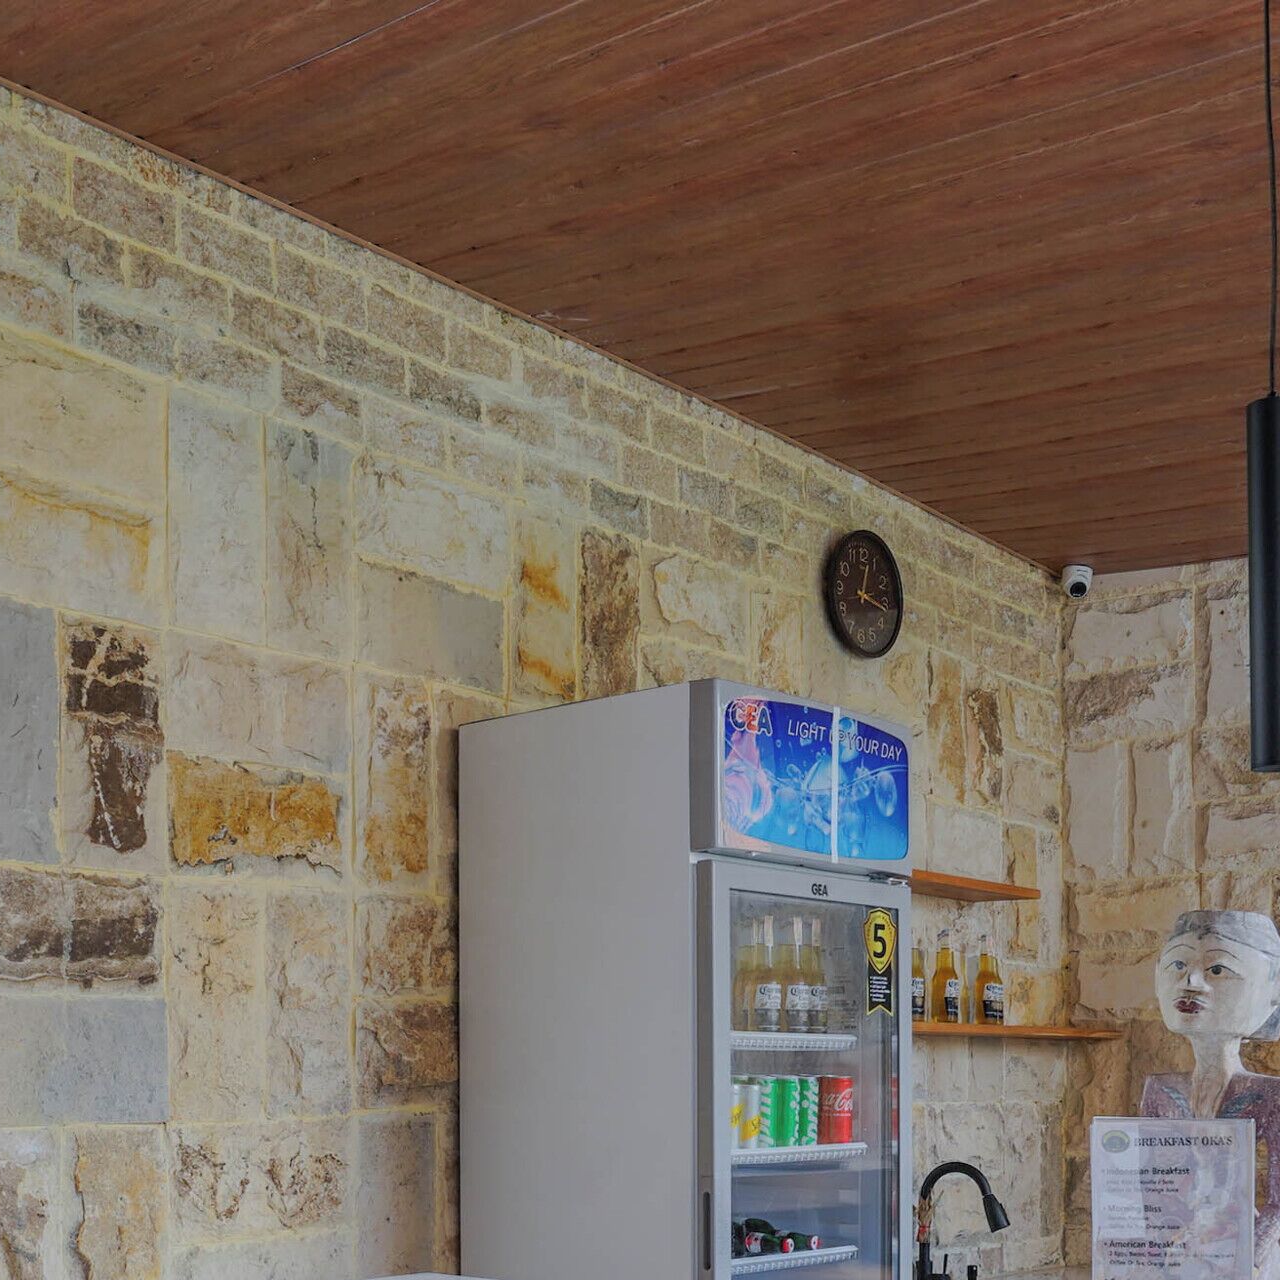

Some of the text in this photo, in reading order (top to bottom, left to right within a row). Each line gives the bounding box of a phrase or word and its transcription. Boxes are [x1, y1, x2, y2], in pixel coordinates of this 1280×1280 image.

[848, 548, 856, 563] 11
[859, 547, 869, 562] 12
[839, 560, 850, 577] 10
[836, 580, 844, 595] 9
[879, 575, 887, 590] 2
[839, 601, 847, 616] 8
[880, 597, 889, 612] 3
[848, 620, 855, 635] 7
[877, 617, 884, 630] 4
[857, 629, 865, 643] 6
[868, 627, 876, 642] 5
[787, 719, 827, 742] LIGHT
[845, 731, 880, 757] YOUR
[880, 742, 903, 762] DAY
[811, 883, 828, 896] GEA
[872, 923, 887, 959] 5
[1134, 1136, 1199, 1147] BREAKFAST
[1152, 1166, 1190, 1176] Breakfast
[1144, 1205, 1162, 1213] Bliss
[1109, 1240, 1186, 1249] American Breakft
